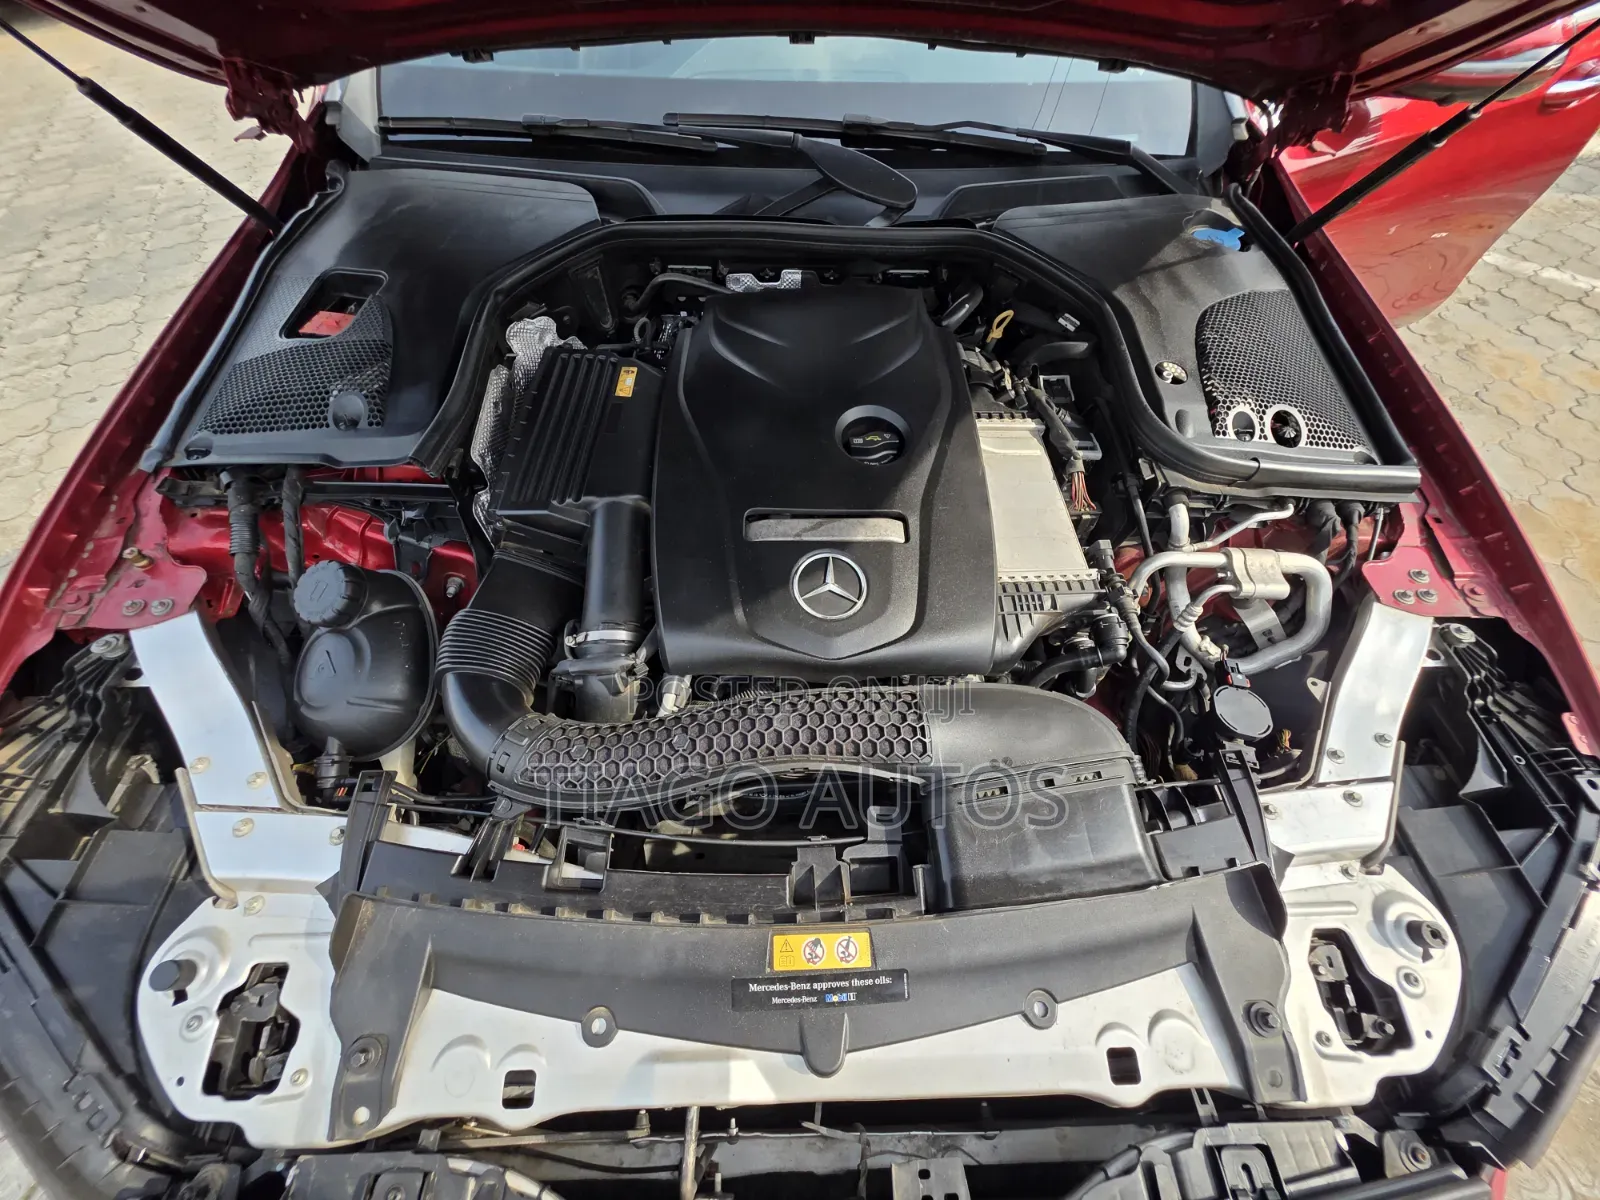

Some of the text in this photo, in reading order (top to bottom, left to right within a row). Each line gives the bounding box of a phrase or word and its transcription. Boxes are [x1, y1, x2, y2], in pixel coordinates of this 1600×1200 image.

[748, 981, 811, 992] Mercedes-Benz
[813, 979, 849, 990] approves
[851, 978, 874, 987] these
[875, 975, 892, 985] oils:
[771, 995, 818, 1004] Mercedes-Benz
